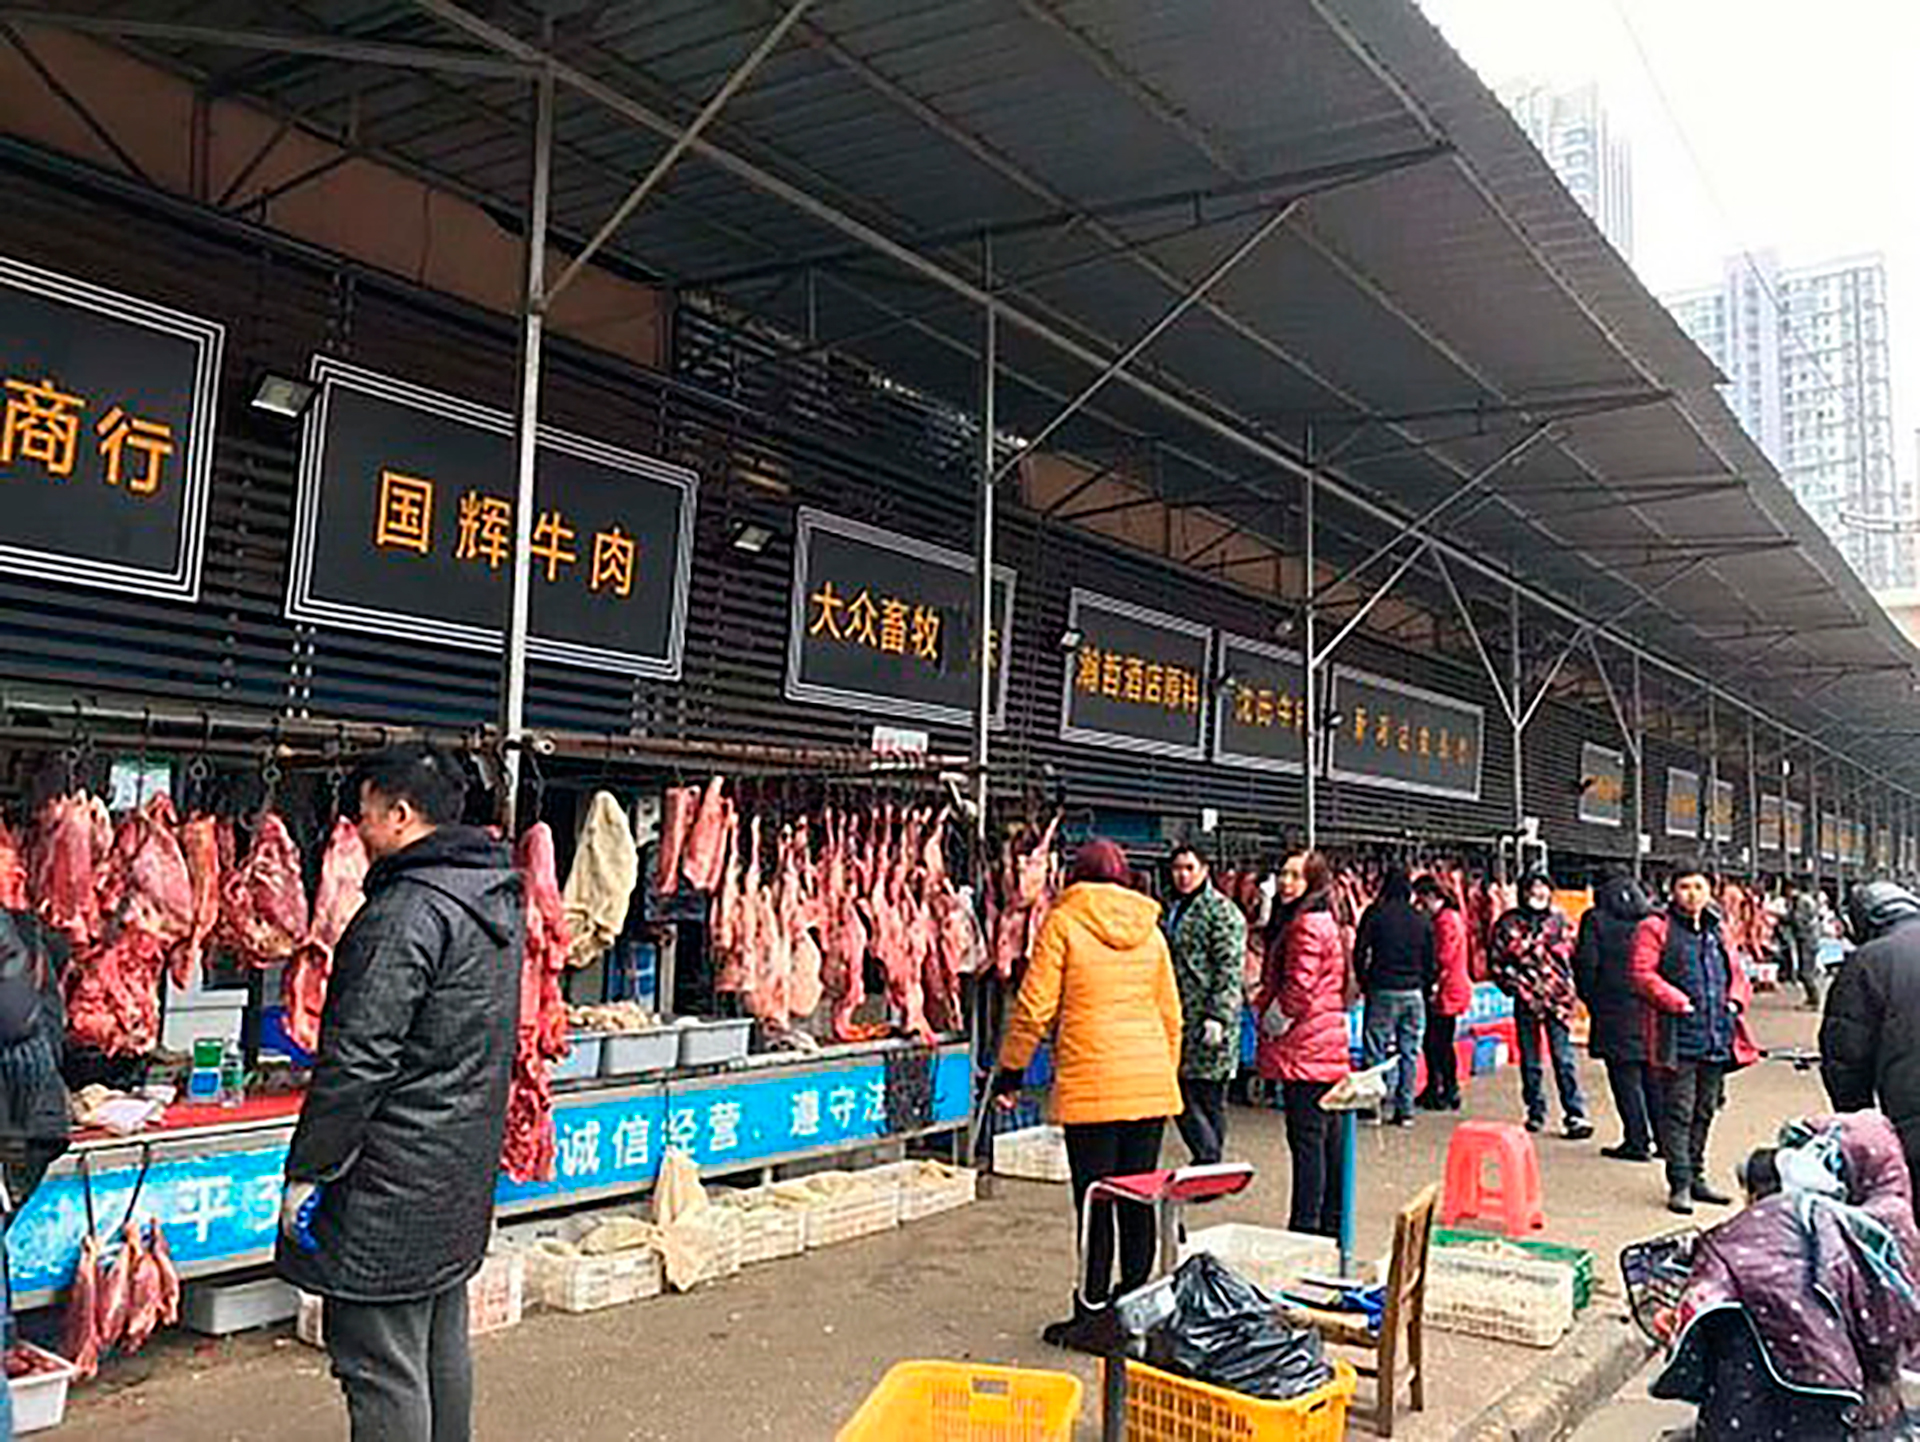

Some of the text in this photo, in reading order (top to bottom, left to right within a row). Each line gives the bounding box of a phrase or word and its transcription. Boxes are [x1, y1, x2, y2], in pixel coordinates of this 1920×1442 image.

[0, 379, 173, 493] 商行
[375, 471, 637, 597] 国辉牛肉
[809, 581, 940, 661] 大众畜牧
